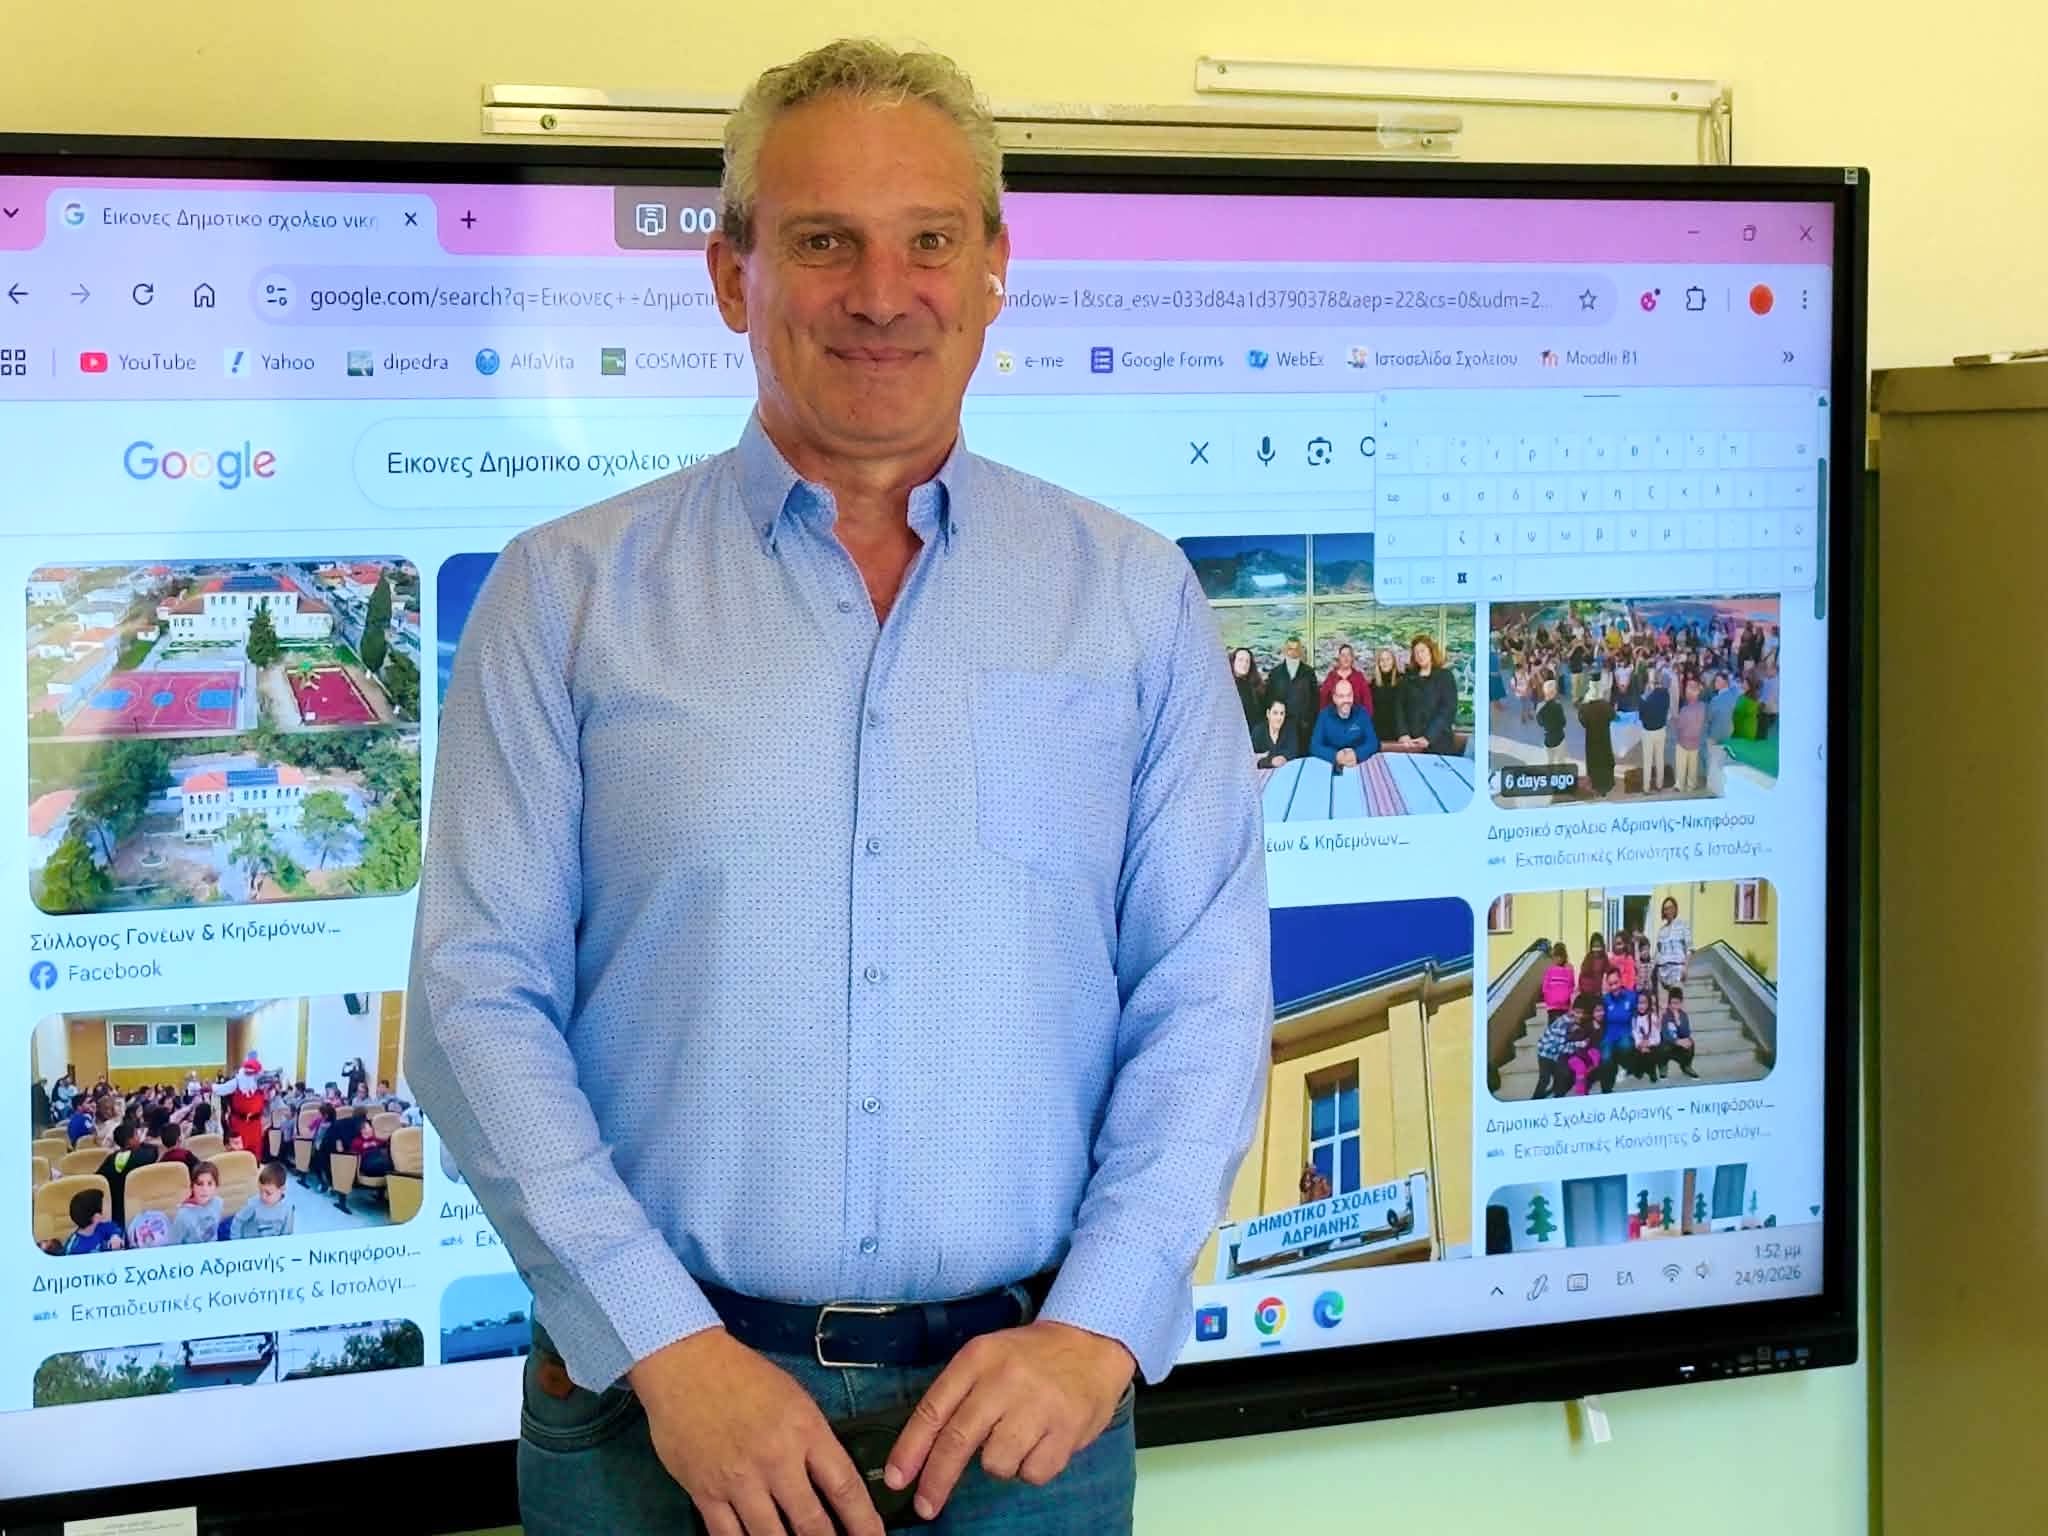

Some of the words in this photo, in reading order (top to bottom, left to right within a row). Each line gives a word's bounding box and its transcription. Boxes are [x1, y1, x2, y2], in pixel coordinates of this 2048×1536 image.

[103, 207, 170, 228] Εικονες
[176, 209, 263, 232] Δημοτικο
[268, 210, 337, 233] σχολειο
[680, 207, 716, 233] 00
[119, 353, 197, 371] YouTube
[261, 353, 315, 371] Yahoo
[383, 352, 449, 374] dipedra
[510, 352, 575, 370] AlfaVita
[635, 352, 718, 370] COSMOTE
[724, 352, 745, 370] TV
[1025, 355, 1065, 368] e-me
[1121, 351, 1175, 371] Google
[1180, 351, 1224, 367] Forms
[1276, 351, 1324, 367] WebEx
[123, 439, 277, 490] Google
[387, 452, 473, 478] Εικονες
[480, 450, 581, 478] Δημοτικο
[587, 448, 670, 477] σχολειο
[1504, 773, 1514, 790] 6
[1516, 773, 1548, 791] days
[1550, 774, 1575, 790] ago
[1299, 835, 1309, 851] &
[30, 932, 121, 952] Σύλλογος
[126, 926, 197, 945] Γονέων
[201, 923, 216, 941] &
[68, 959, 163, 983] Facebook
[1247, 1202, 1327, 1238] ΔΗΜΟΤΙΚΟ
[1281, 1213, 1360, 1247] ΑΔΡΙΑΝΗΣ
[32, 1268, 118, 1295] Δημοτικό
[200, 1251, 286, 1278] Αδριανής
[71, 1293, 203, 1322] Εκπαιδευτικές
[209, 1285, 305, 1308] Κοινότητες
[311, 1280, 325, 1299] &
